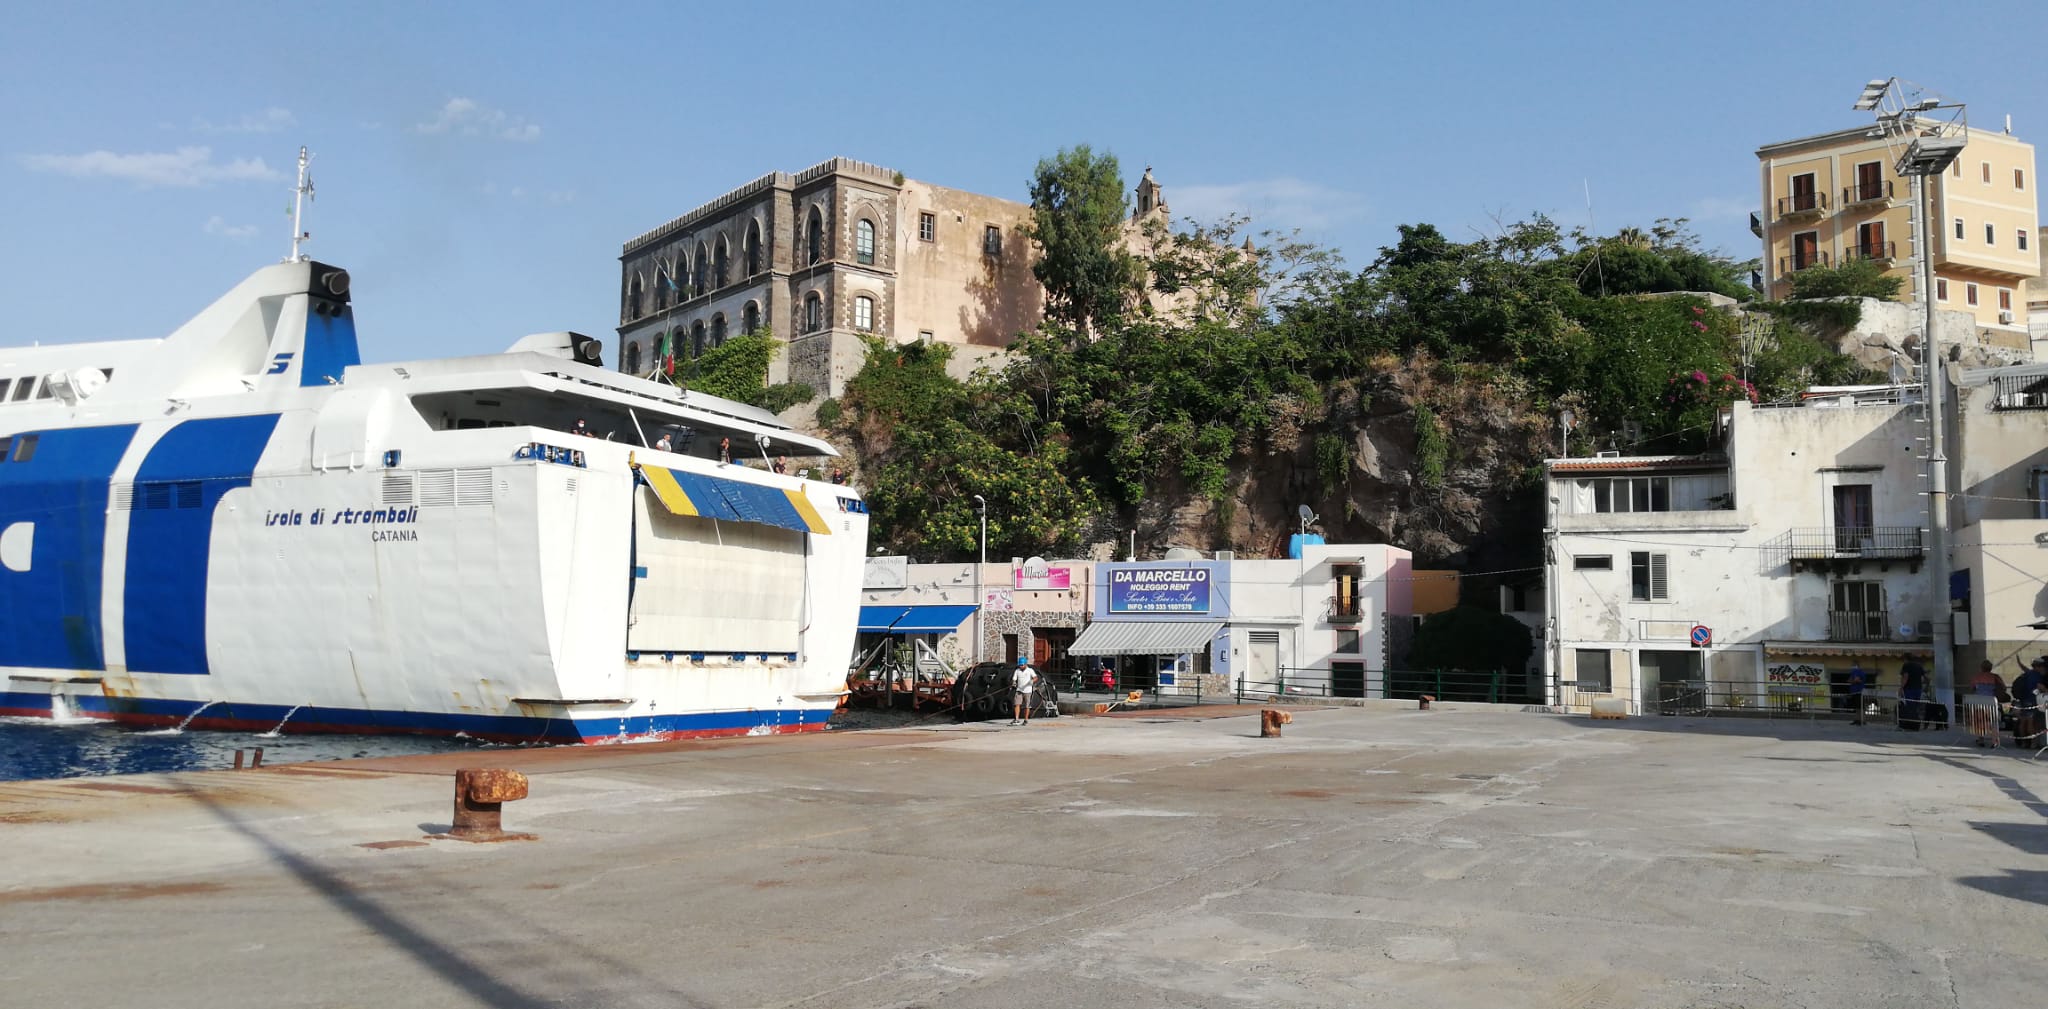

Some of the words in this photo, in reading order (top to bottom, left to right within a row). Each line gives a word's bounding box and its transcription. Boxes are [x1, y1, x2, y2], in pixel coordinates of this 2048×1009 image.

[310, 508, 326, 525] di
[332, 505, 419, 525] stromboli
[371, 530, 418, 543] CATANIA
[1115, 571, 1133, 582] DA
[1135, 570, 1206, 582] MARCELLO
[1130, 583, 1169, 591] NOLEGGIO
[1170, 583, 1191, 591] RENT
[1769, 674, 1788, 682] PIT
[1792, 675, 1821, 683] STOP
